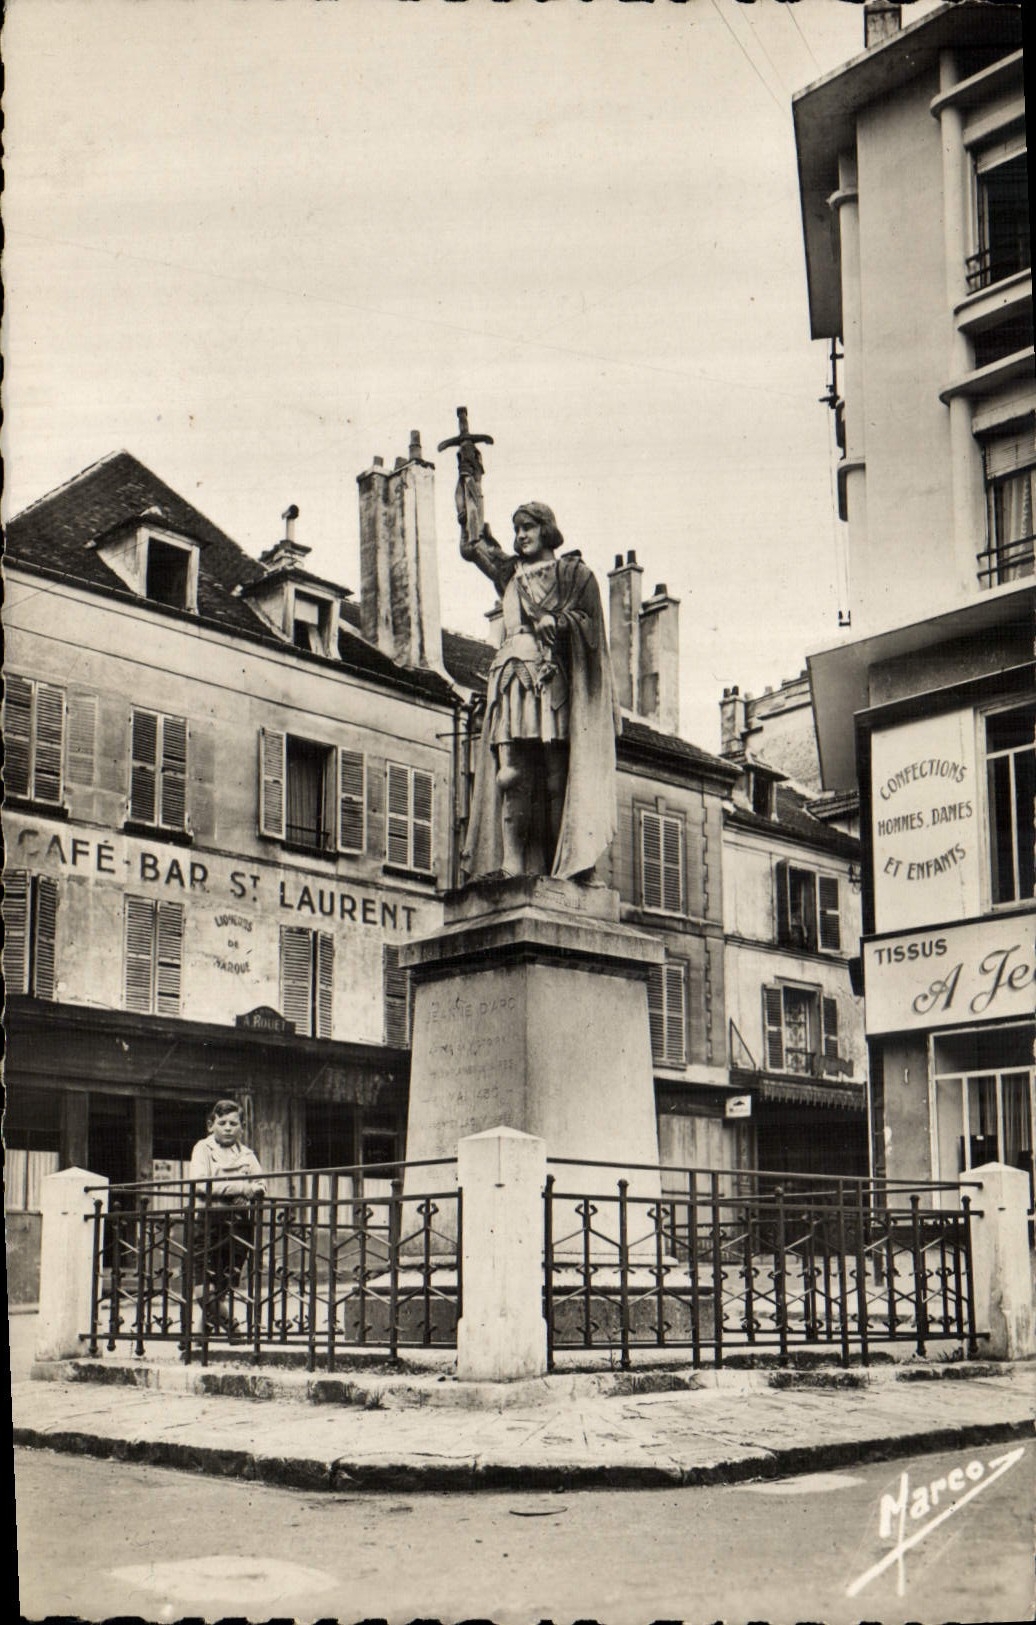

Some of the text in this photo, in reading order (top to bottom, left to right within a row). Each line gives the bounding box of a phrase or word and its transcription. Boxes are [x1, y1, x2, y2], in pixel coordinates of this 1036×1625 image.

[879, 759, 968, 801] CONFECTIONS
[931, 801, 973, 826] DAMES
[883, 843, 967, 880] ET ENFANTS
[279, 880, 418, 934] LAURENT
[227, 939, 240, 949] DE
[874, 938, 948, 966] TISSUS
[913, 944, 1036, 1015] A Je
